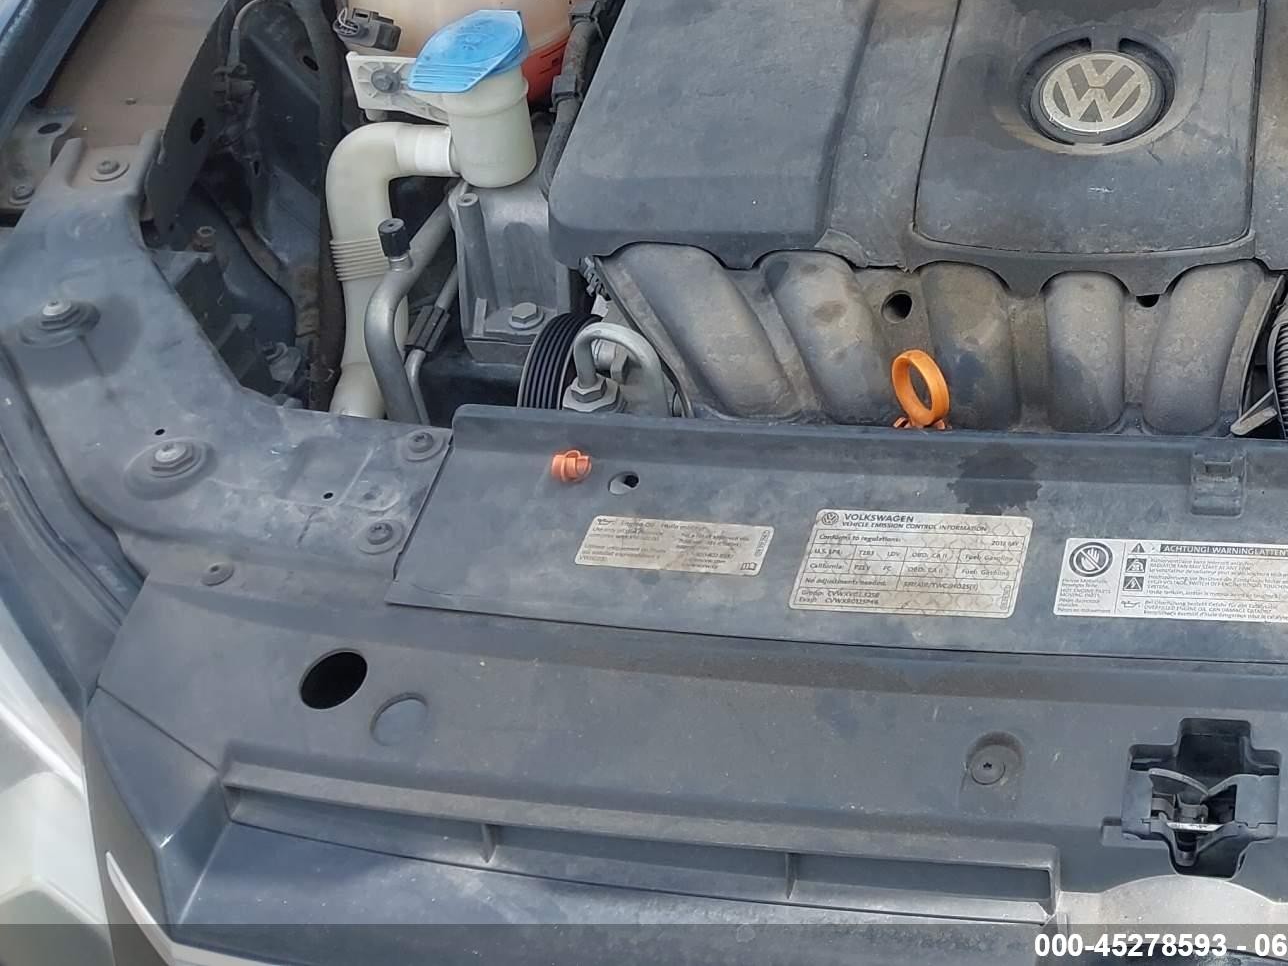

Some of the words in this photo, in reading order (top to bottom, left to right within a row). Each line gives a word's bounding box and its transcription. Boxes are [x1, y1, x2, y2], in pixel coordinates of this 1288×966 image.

[844, 513, 914, 523] VOLKSWAGEN
[1164, 545, 1209, 554] ACHTUNG!
[1212, 547, 1258, 555] WARNING!
